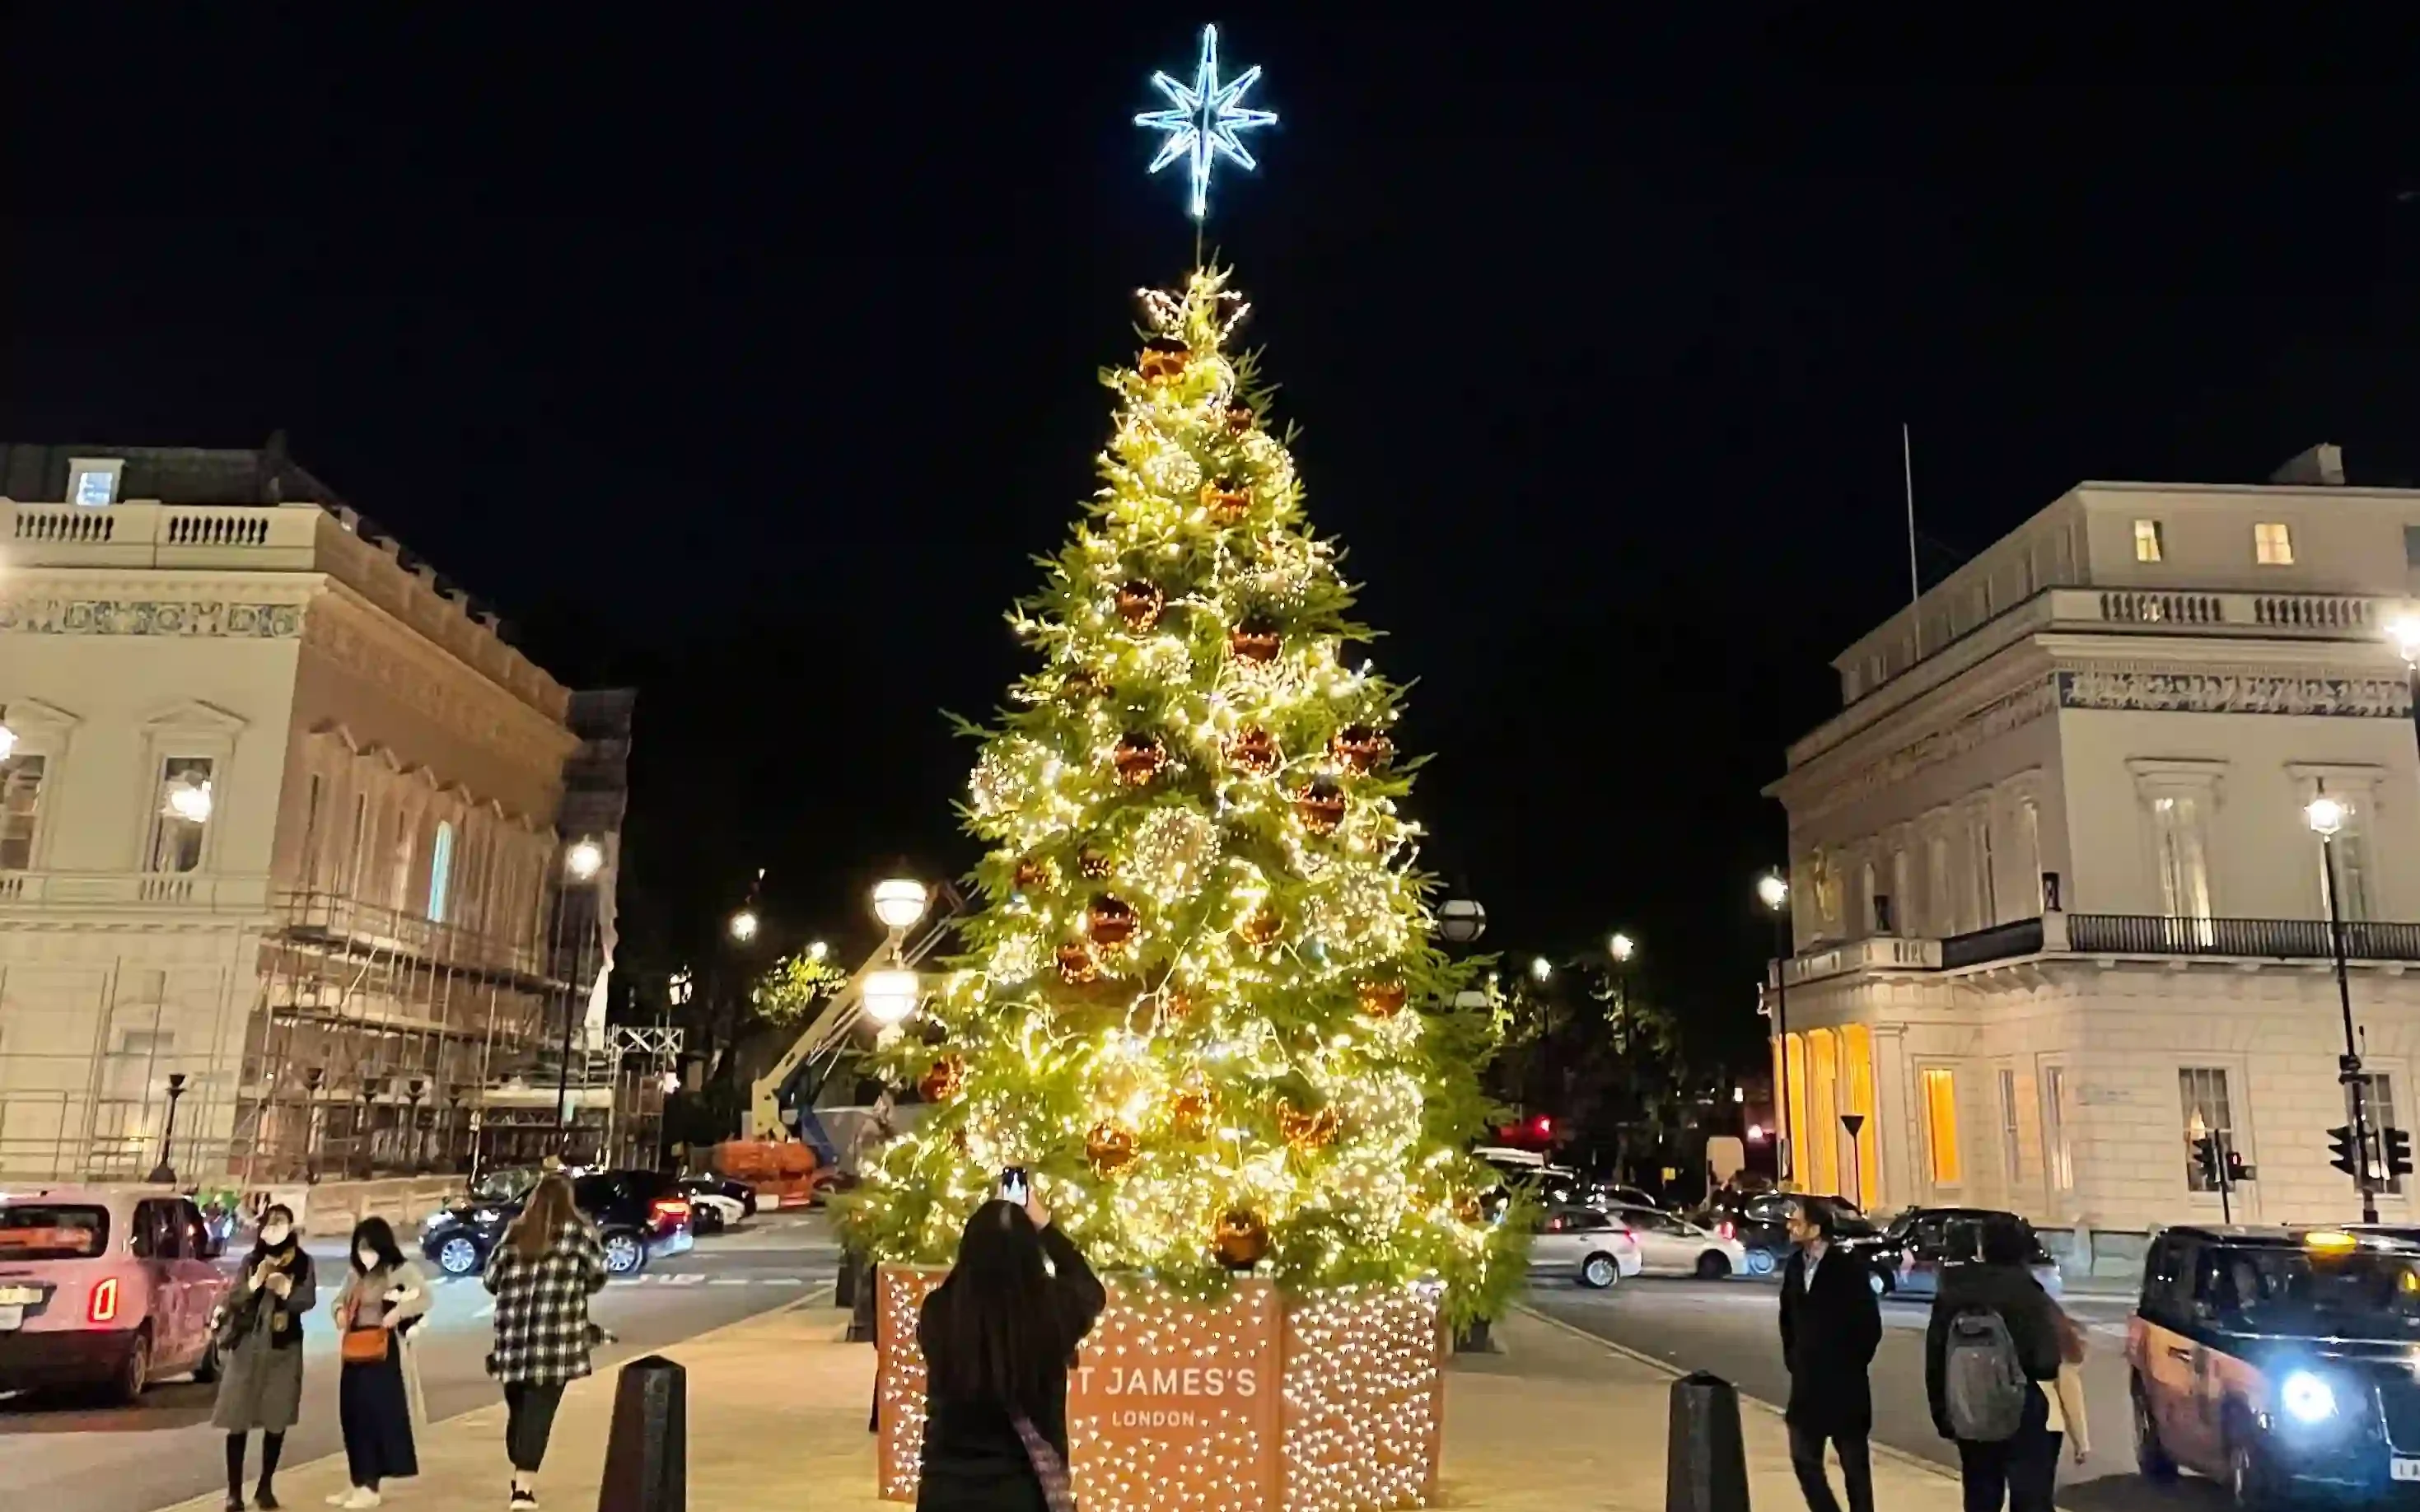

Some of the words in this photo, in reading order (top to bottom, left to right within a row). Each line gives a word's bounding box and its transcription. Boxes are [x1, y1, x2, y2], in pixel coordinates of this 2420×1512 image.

[1067, 1366, 1095, 1395] T
[1105, 1367, 1257, 1397] JAMES'S
[1112, 1410, 1195, 1428] LONDON
